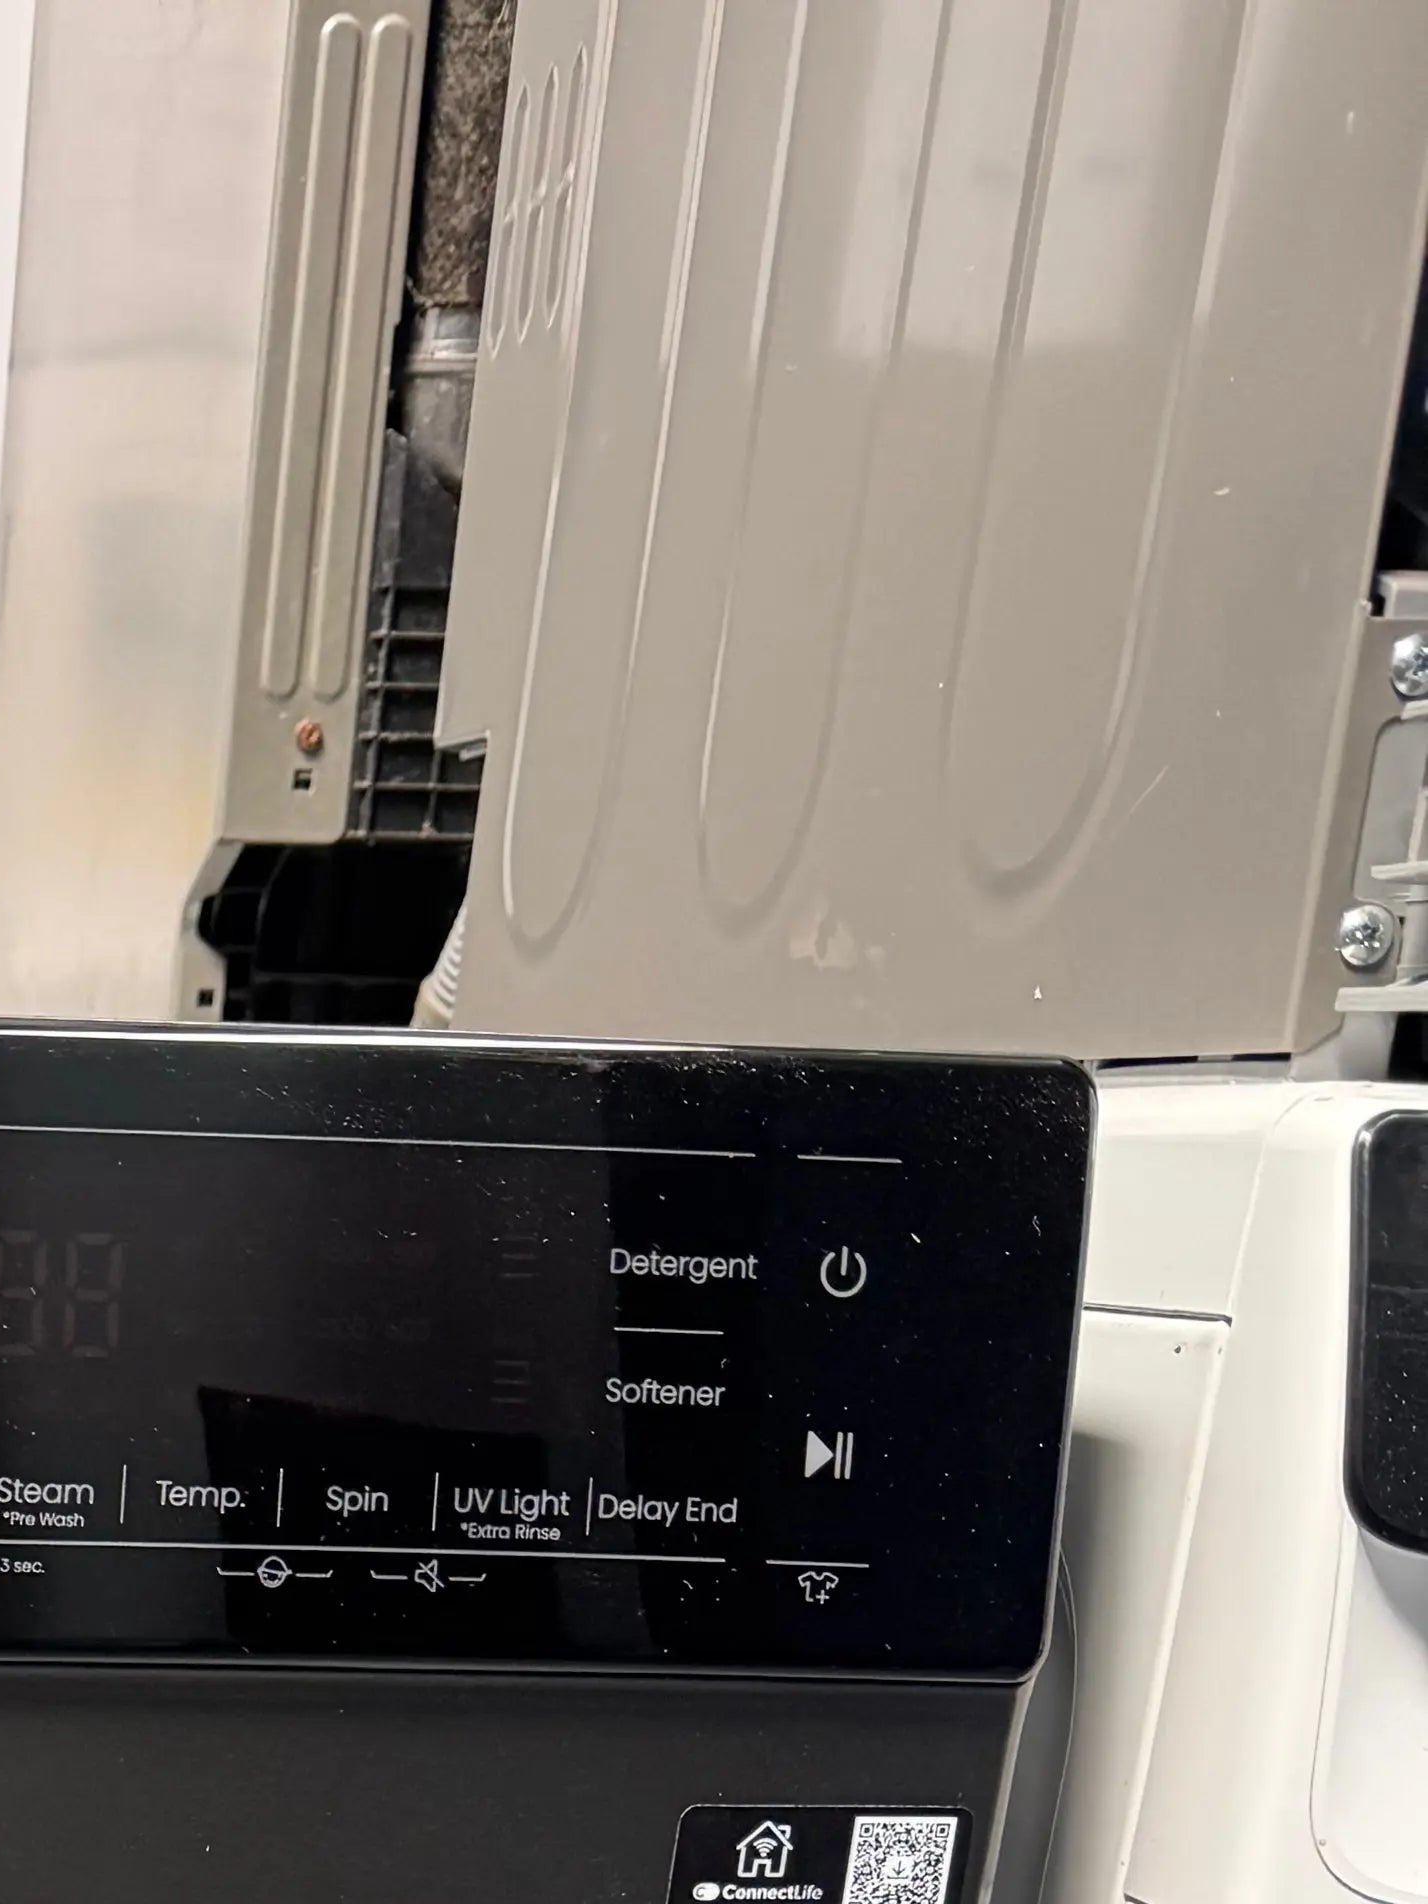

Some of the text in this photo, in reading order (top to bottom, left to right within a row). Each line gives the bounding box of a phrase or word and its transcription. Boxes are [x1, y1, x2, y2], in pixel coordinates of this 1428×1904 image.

[609, 1248, 758, 1283] Detergent
[604, 1378, 725, 1407] Softener
[156, 1480, 246, 1513] Temp.
[325, 1486, 389, 1514] Spin
[454, 1487, 570, 1522] UV Light
[598, 1494, 738, 1527] Delay End
[40, 1513, 84, 1528] Wash
[515, 1524, 561, 1541] Rinse
[0, 1559, 10, 1573] 3
[13, 1561, 45, 1574] sec.
[722, 1883, 823, 1900] ConnectLife
